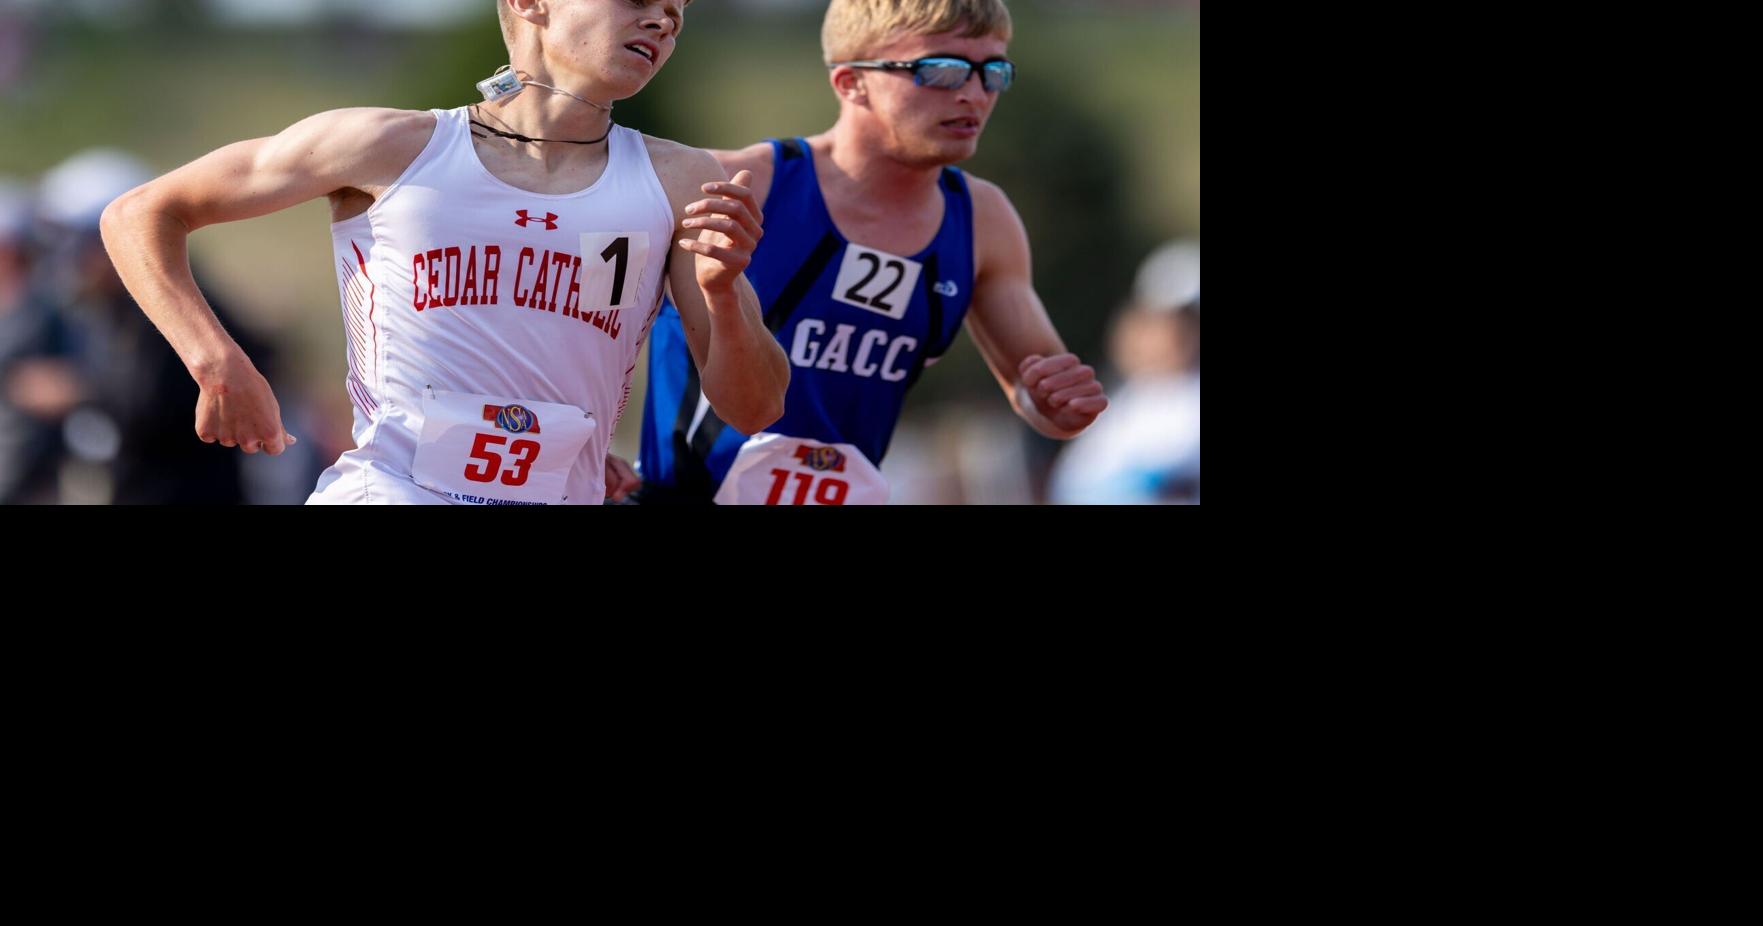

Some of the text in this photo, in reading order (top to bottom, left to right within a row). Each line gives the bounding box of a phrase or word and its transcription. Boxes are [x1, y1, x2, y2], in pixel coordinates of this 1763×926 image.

[412, 245, 621, 340] CEDAR CATH
[600, 237, 629, 306] 1
[844, 252, 906, 313] 22
[790, 318, 918, 382] GACC
[463, 432, 541, 486] 53
[462, 494, 485, 504] FIELD
